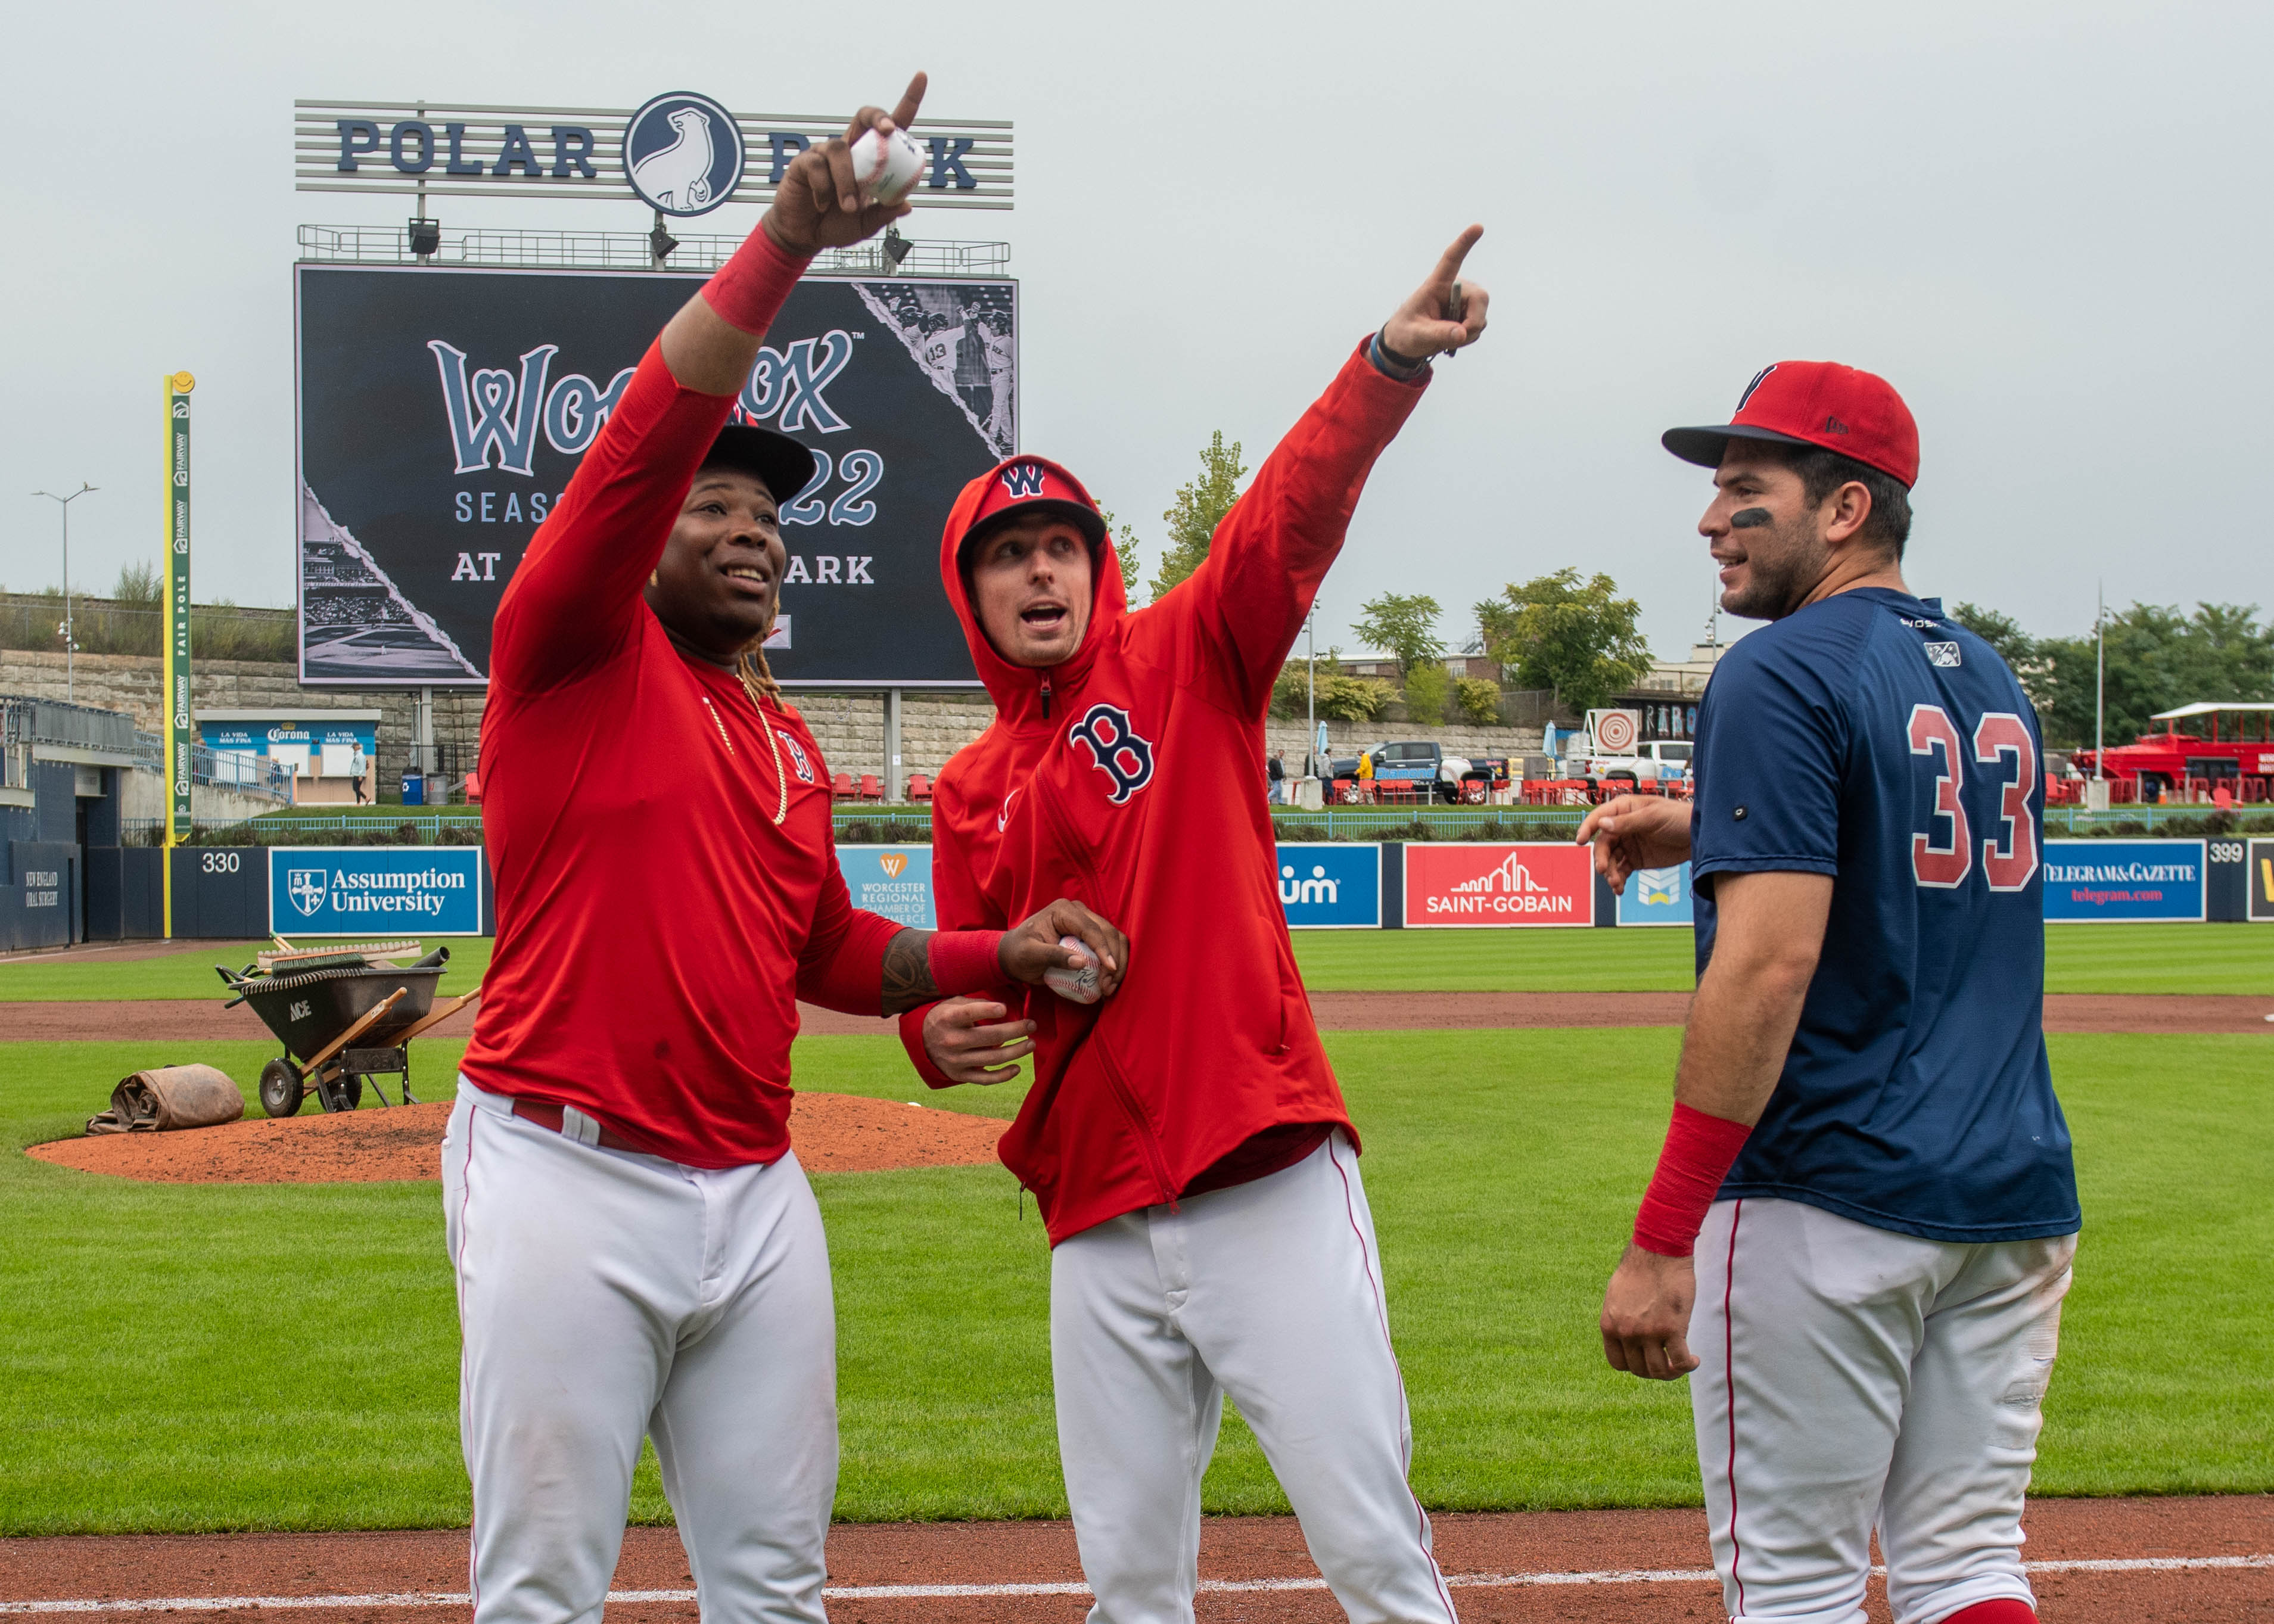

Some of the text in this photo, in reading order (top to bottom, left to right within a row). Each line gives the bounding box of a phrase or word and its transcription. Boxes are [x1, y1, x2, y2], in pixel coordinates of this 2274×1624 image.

[337, 119, 597, 178] POLAR
[769, 132, 977, 188] PK
[929, 343, 947, 361] 13
[176, 432, 184, 471] FAIRWAY
[455, 448, 884, 526] SEAS 22
[1002, 463, 1045, 499] W
[176, 499, 185, 538] FAIRWAY
[451, 552, 875, 584] AT ARK
[178, 575, 186, 657] FAIR POLE
[177, 674, 186, 713] FAIRWAY
[267, 728, 310, 743] Corona
[177, 742, 186, 780] FAIRWAY
[777, 730, 814, 783] B
[1069, 703, 1155, 805] B
[1376, 767, 1437, 779] Diamond
[1907, 704, 2038, 892] 33
[203, 853, 239, 873] 330
[2210, 843, 2244, 863] 399
[331, 867, 466, 894] Assumption
[862, 883, 925, 892] WORCESTER
[1278, 865, 1338, 904] um
[332, 891, 446, 916] University
[862, 893, 926, 903] REGIONAL
[912, 903, 925, 913] OF
[1426, 895, 1573, 913] SAINT-GOBAIN
[2071, 887, 2163, 906] telegram.com
[885, 914, 926, 924] MERCE
[290, 1000, 312, 1022] ACE
